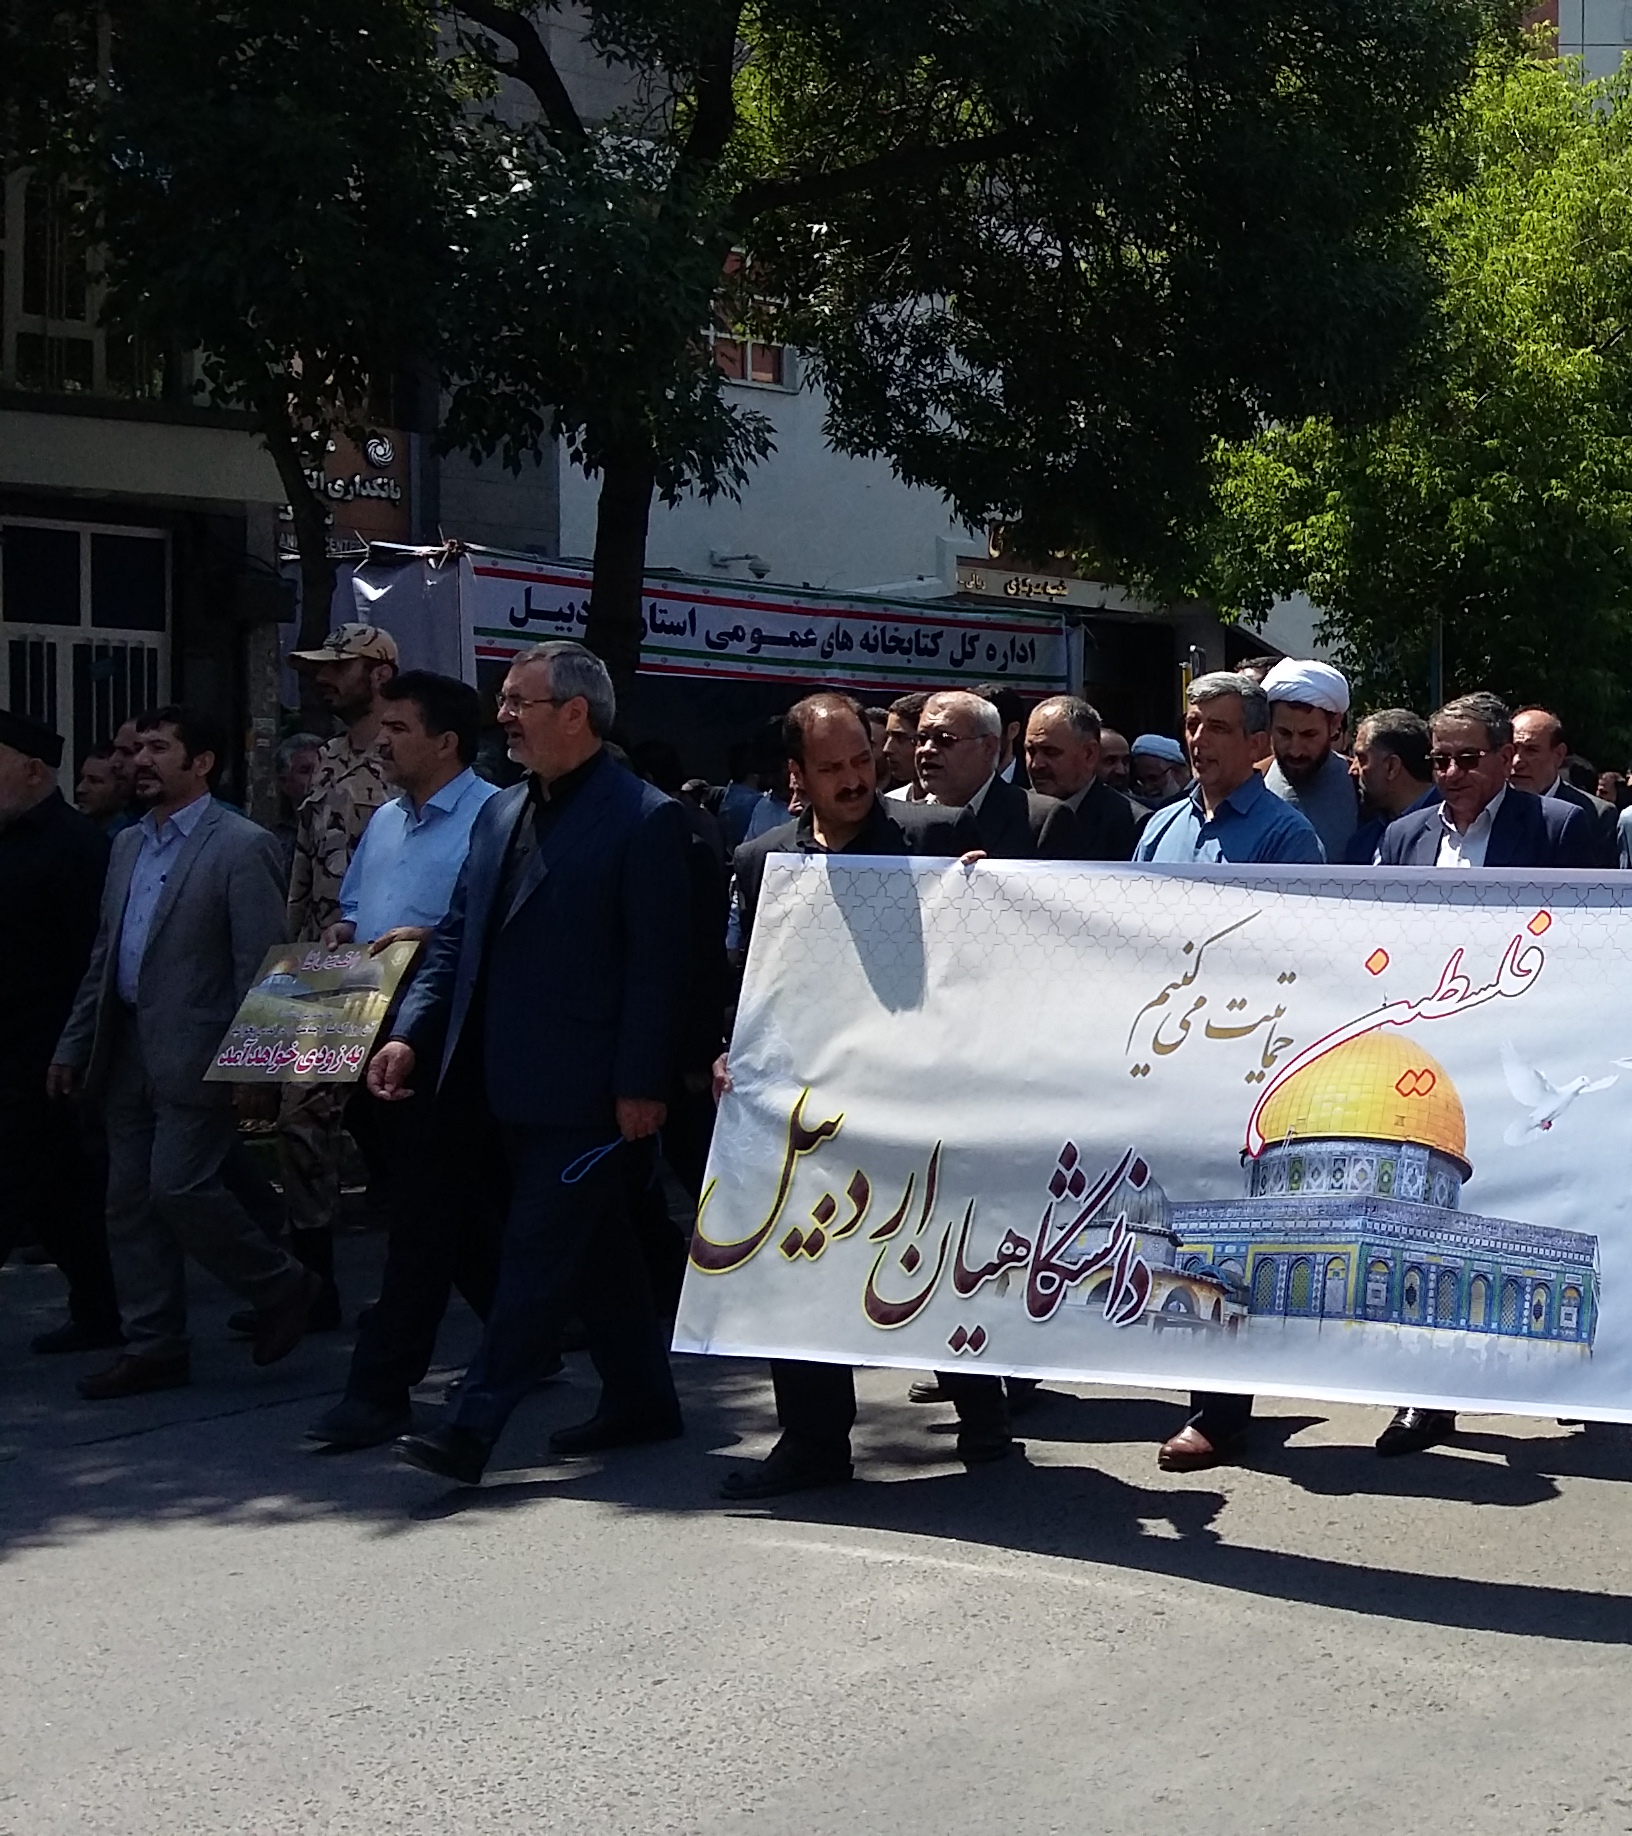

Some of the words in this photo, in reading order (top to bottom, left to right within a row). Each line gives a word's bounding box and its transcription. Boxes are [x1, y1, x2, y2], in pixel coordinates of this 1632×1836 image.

[509, 586, 592, 632] دبیل
[704, 623, 818, 654] عمومی
[820, 622, 854, 660] های
[859, 624, 944, 663] کتابخانه
[949, 631, 980, 667] کل
[986, 636, 1036, 672] اداره
[1204, 970, 1296, 1084] حمایت
[1244, 908, 1553, 1160] فلسطین
[218, 1038, 258, 1067] آمد
[246, 1040, 300, 1074] خواهد
[294, 1044, 346, 1074] زودی
[686, 1085, 944, 1276] اردبیل
[862, 1139, 1153, 1357] دانشگاهیان
